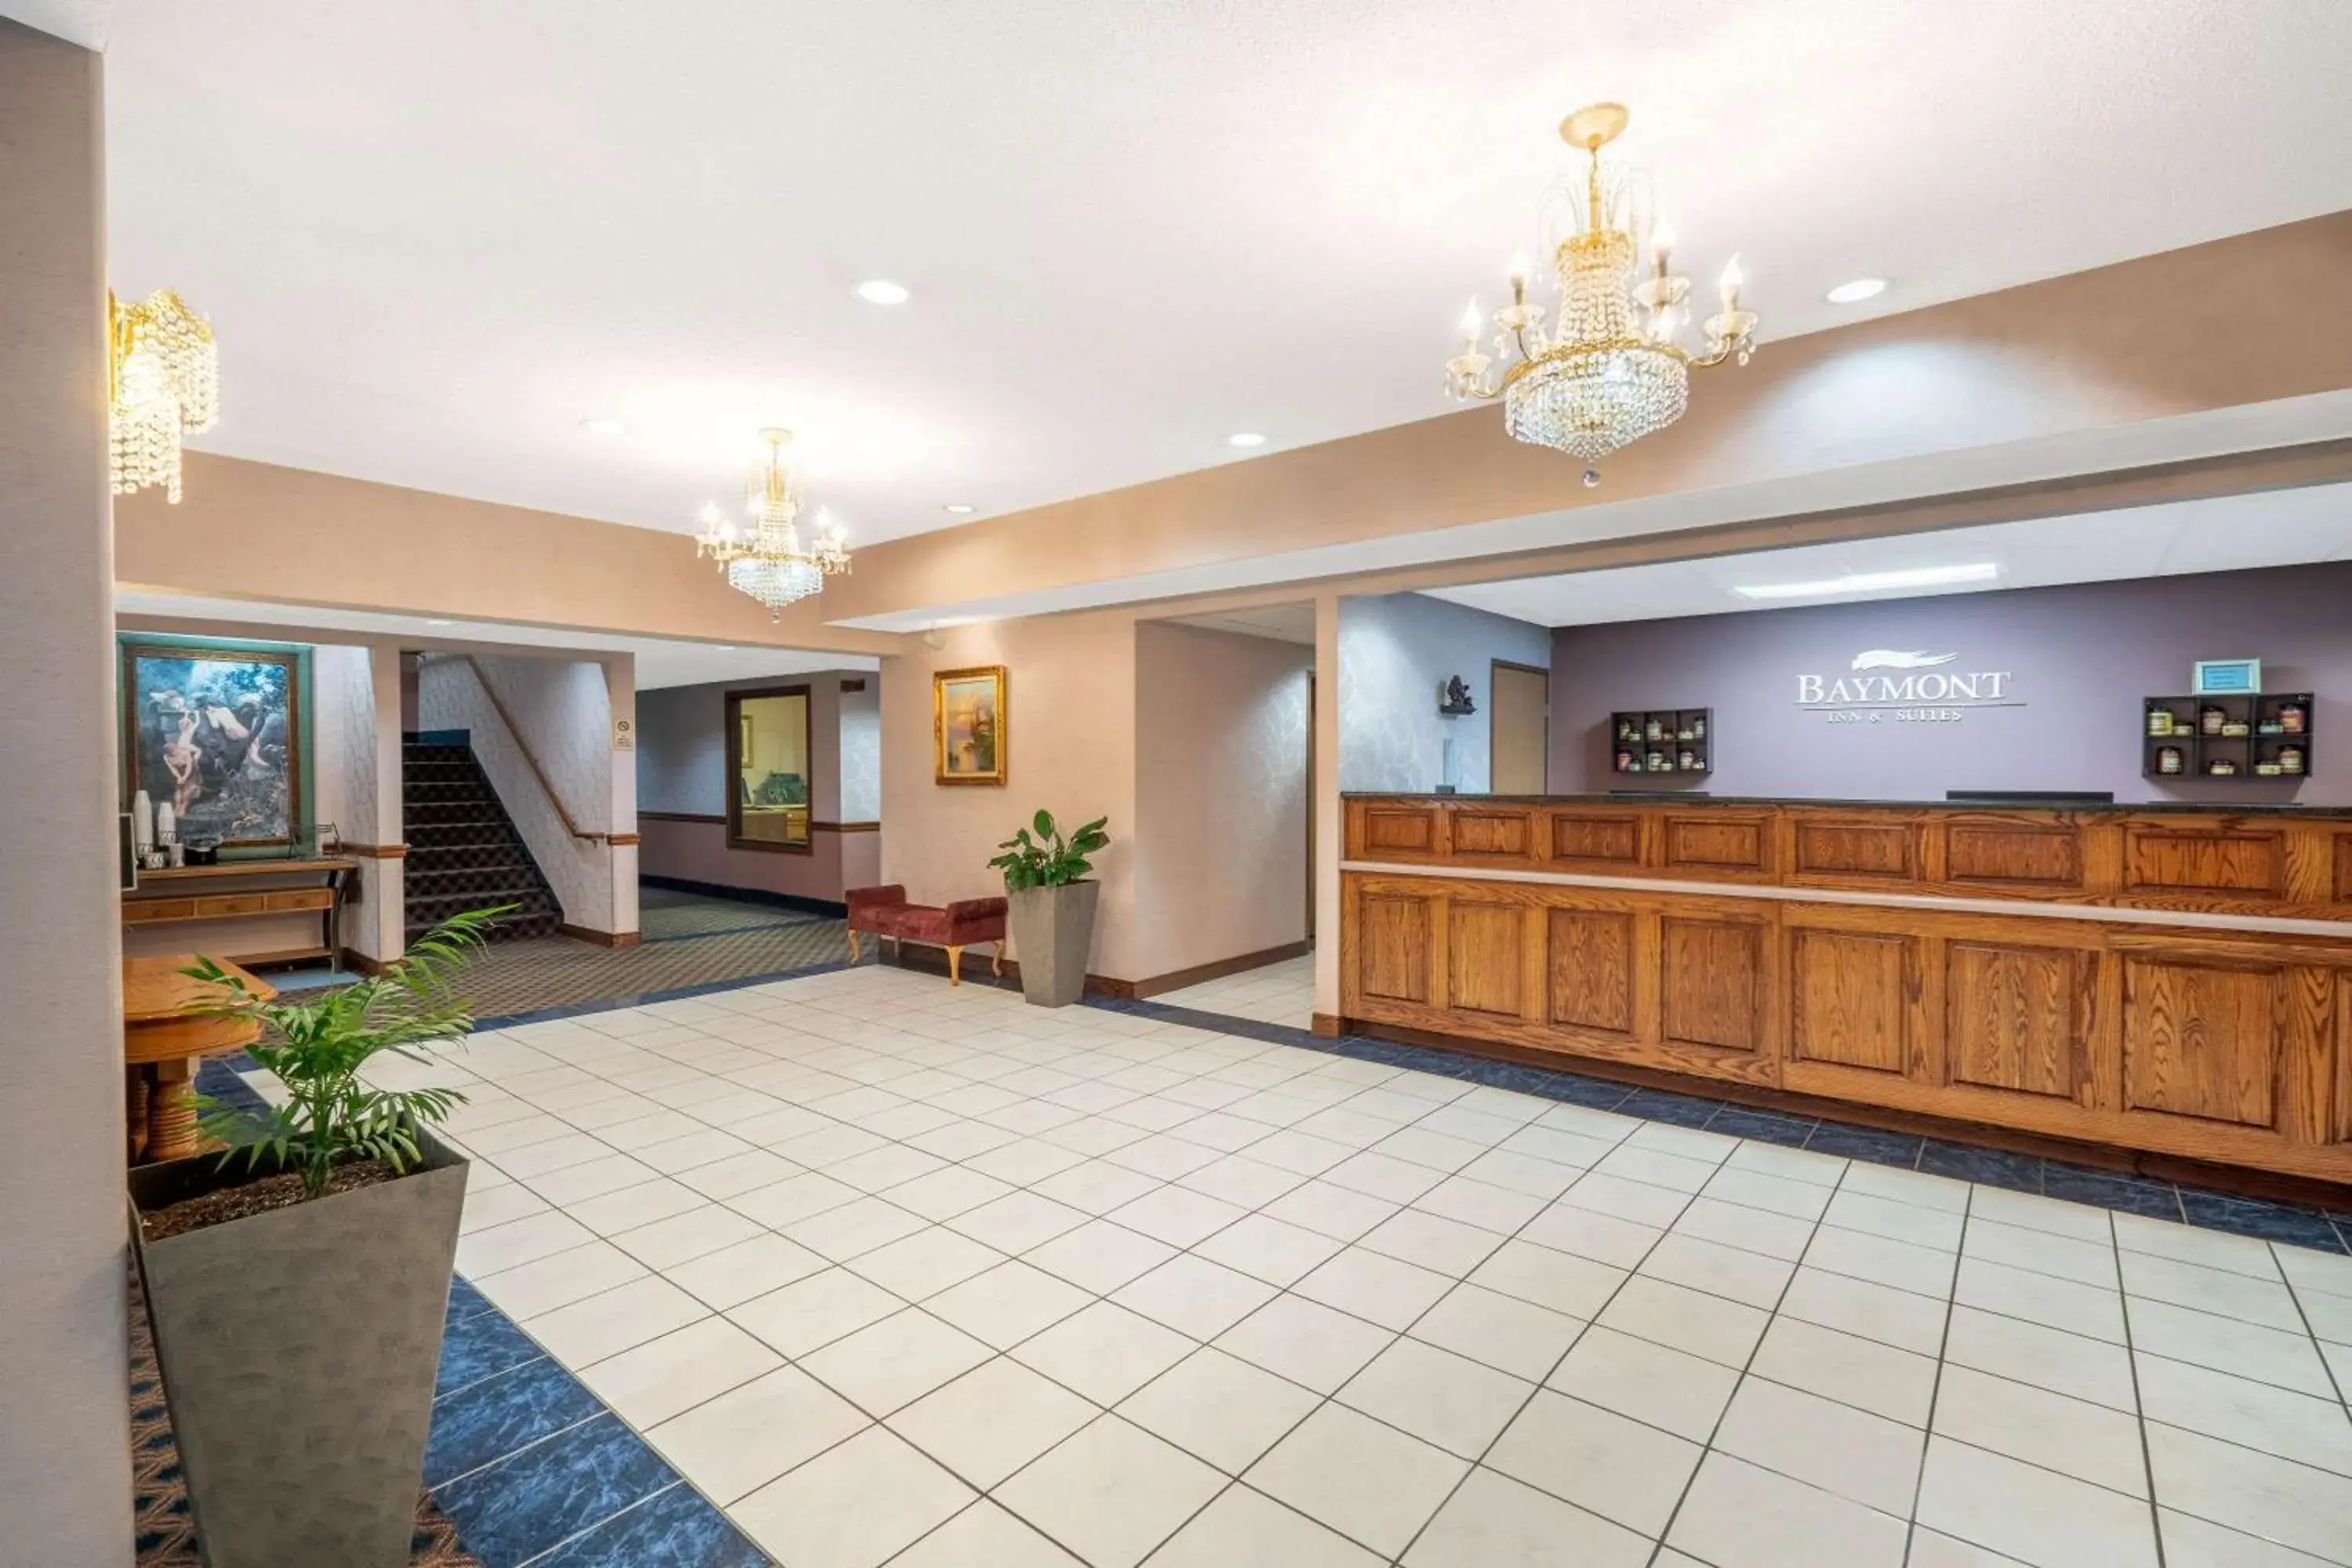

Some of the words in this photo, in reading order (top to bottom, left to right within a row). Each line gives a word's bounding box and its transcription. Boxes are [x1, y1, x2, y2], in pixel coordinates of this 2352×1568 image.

[1796, 672, 2012, 703] BAYMONT
[1827, 710, 1863, 723] INN
[1868, 712, 1882, 723] &
[1896, 708, 1963, 722] SUITES
